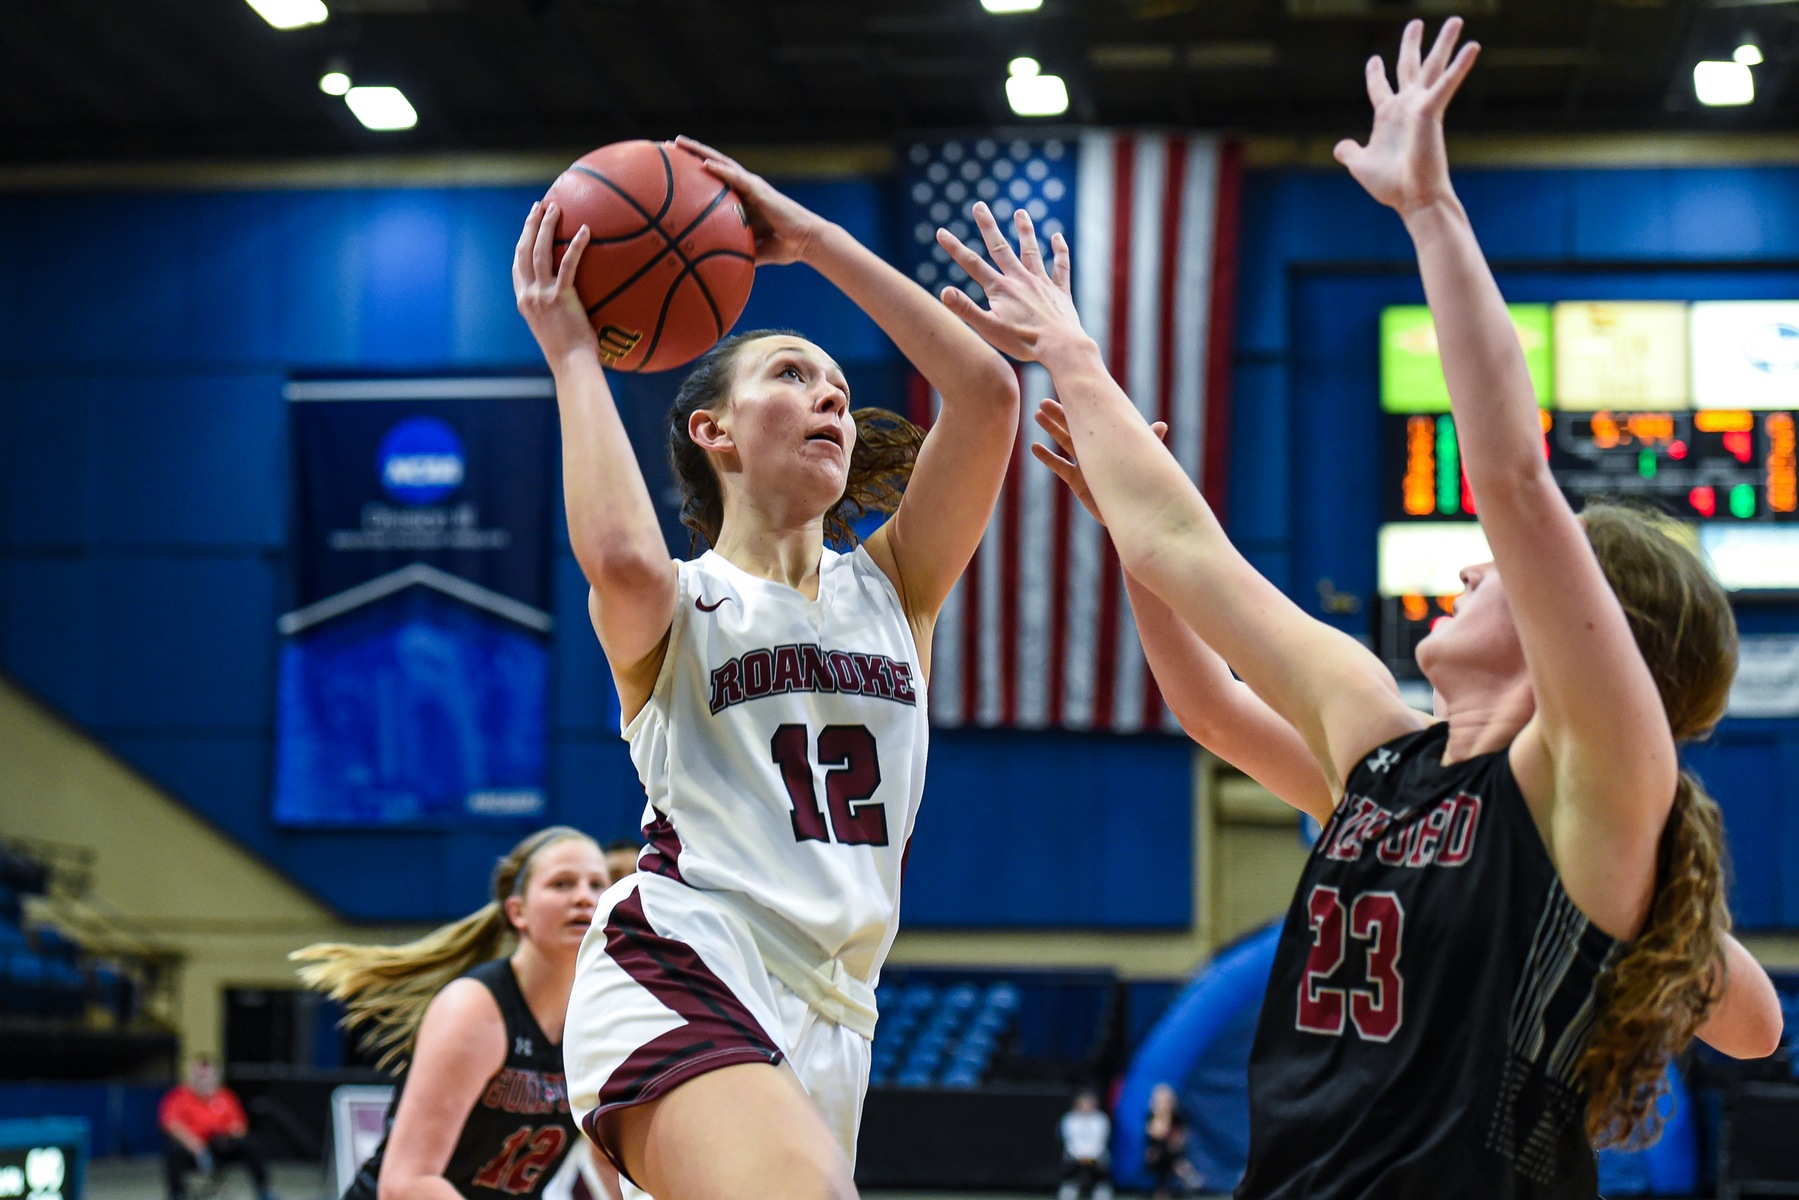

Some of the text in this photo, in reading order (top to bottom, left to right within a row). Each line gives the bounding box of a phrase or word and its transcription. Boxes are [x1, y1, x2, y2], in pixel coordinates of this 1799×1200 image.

[709, 643, 917, 716] ROANOKE
[770, 723, 889, 846] 12
[1296, 885, 1404, 1043] 23
[471, 1124, 567, 1195] 12
